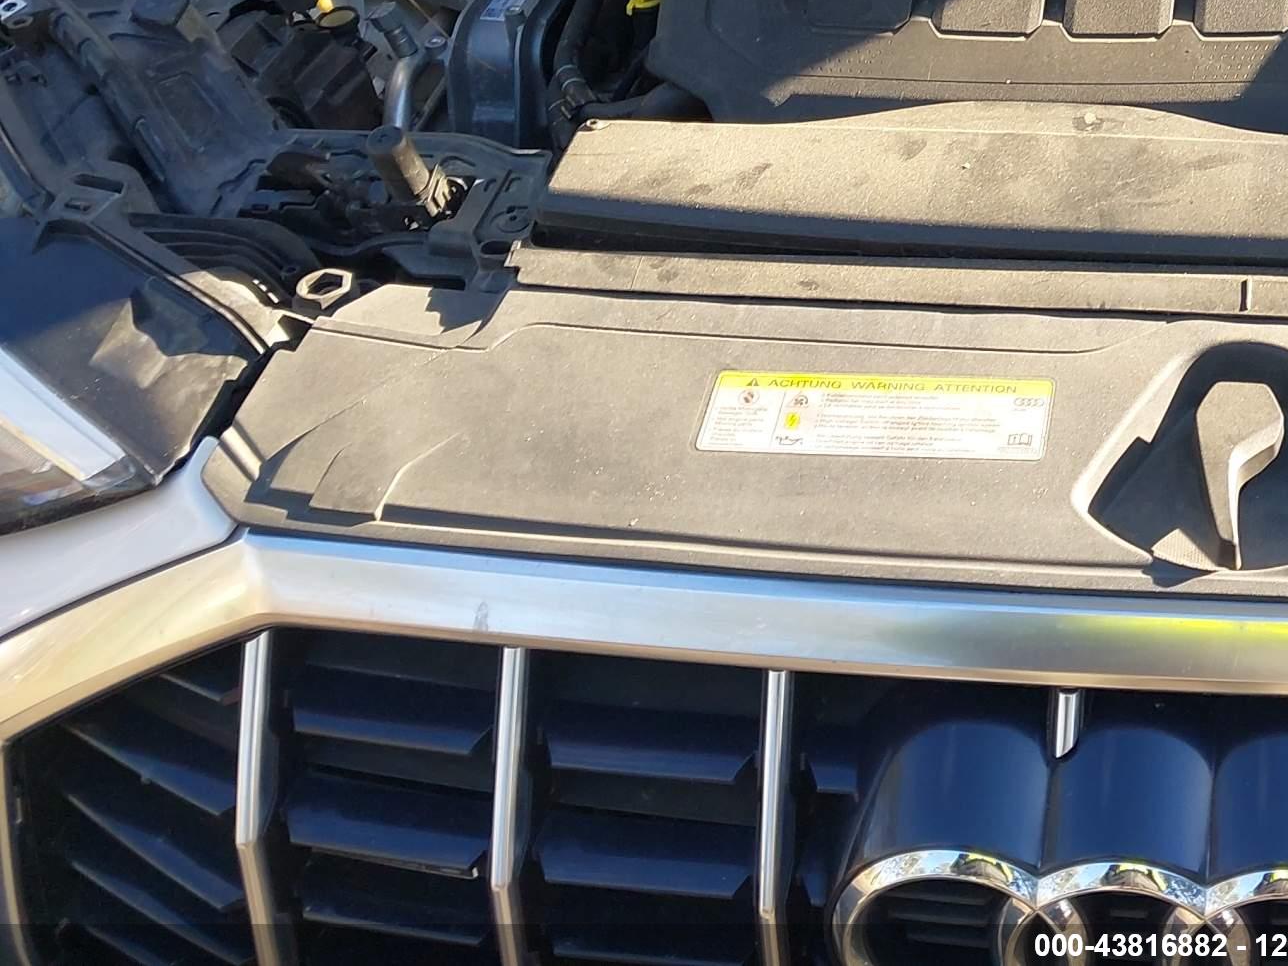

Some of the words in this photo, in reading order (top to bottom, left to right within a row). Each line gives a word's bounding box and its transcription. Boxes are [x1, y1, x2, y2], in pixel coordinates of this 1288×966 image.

[767, 378, 842, 390] ACHTUNG
[852, 380, 926, 392] WARNING
[933, 382, 1017, 394] ATTENTION
